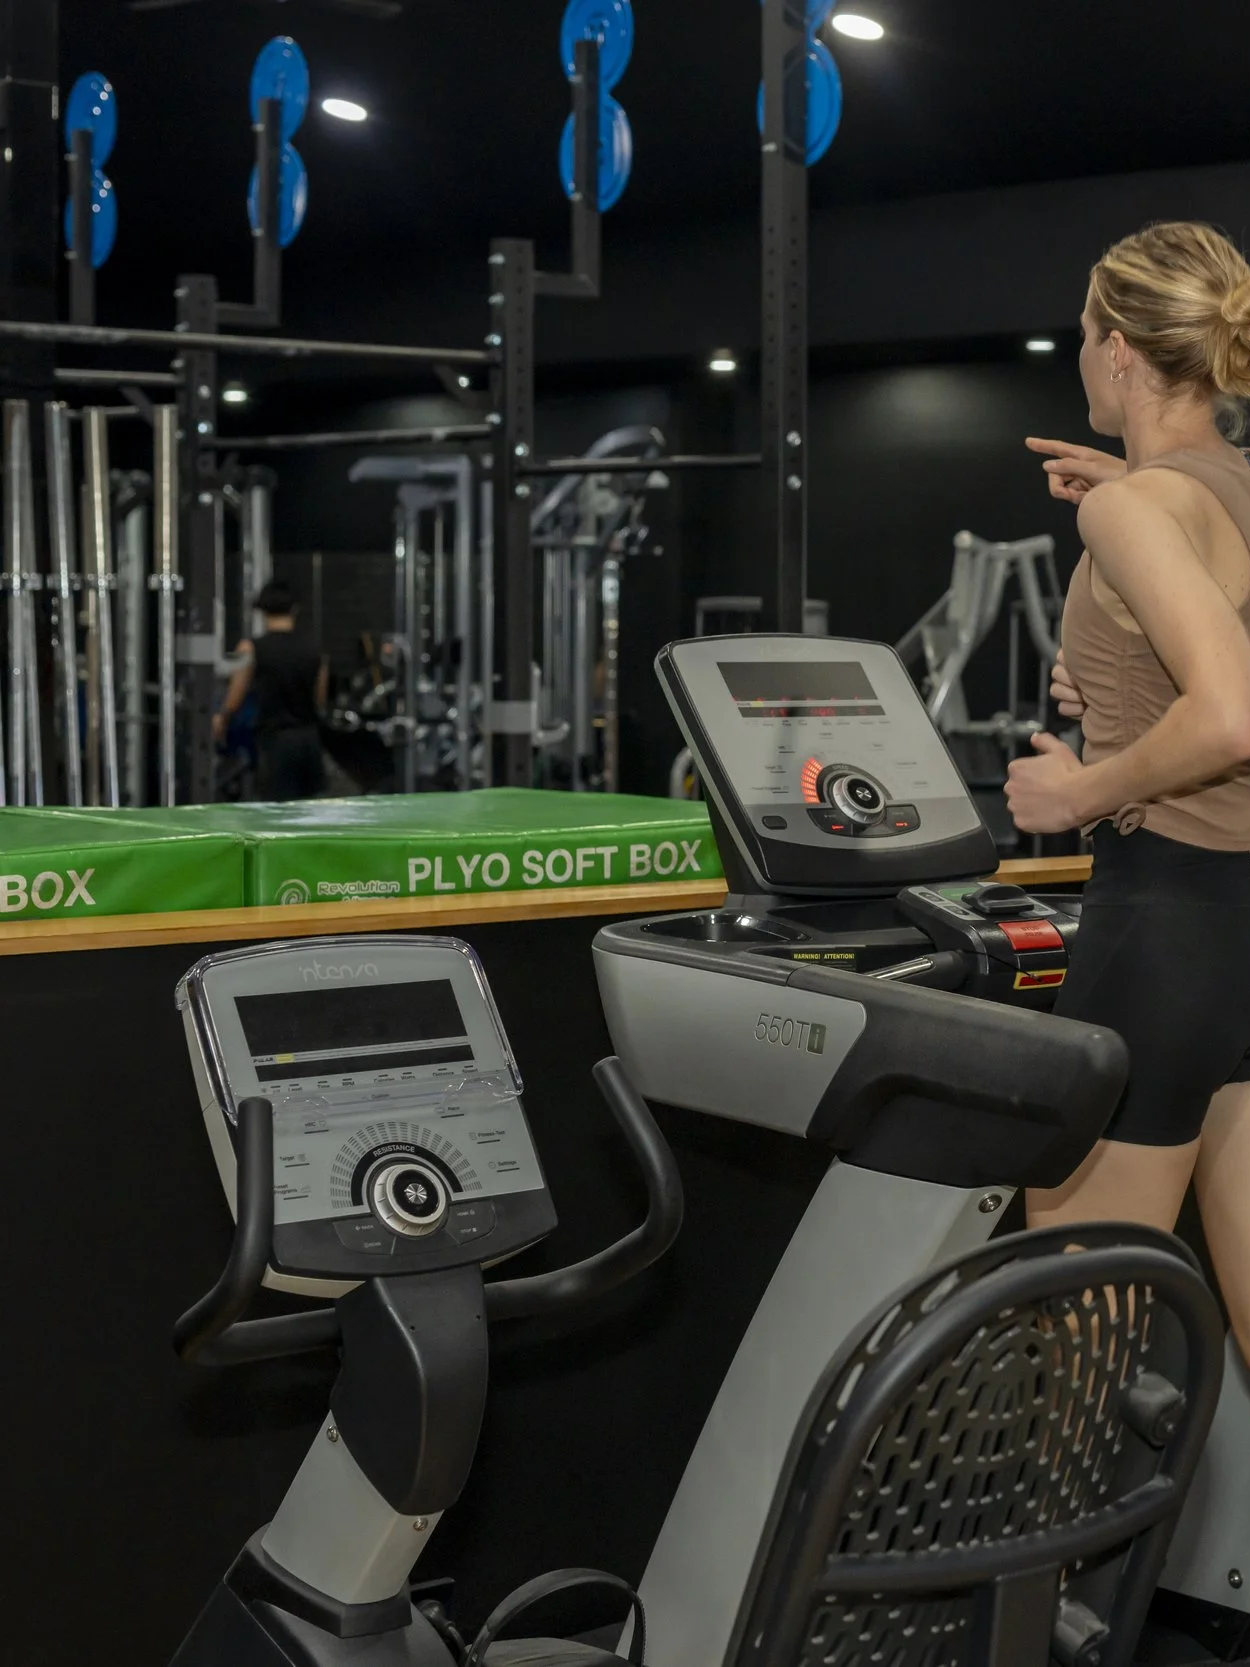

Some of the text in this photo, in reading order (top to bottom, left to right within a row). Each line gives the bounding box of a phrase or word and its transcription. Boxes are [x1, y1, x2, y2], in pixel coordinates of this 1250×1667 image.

[407, 838, 702, 893] PLYO SOFT BOX
[0, 867, 97, 913] BOX
[316, 879, 400, 896] Revolution
[793, 952, 855, 960] WARNING! ATTENTION!
[372, 1144, 416, 1158] RESISTANCE
